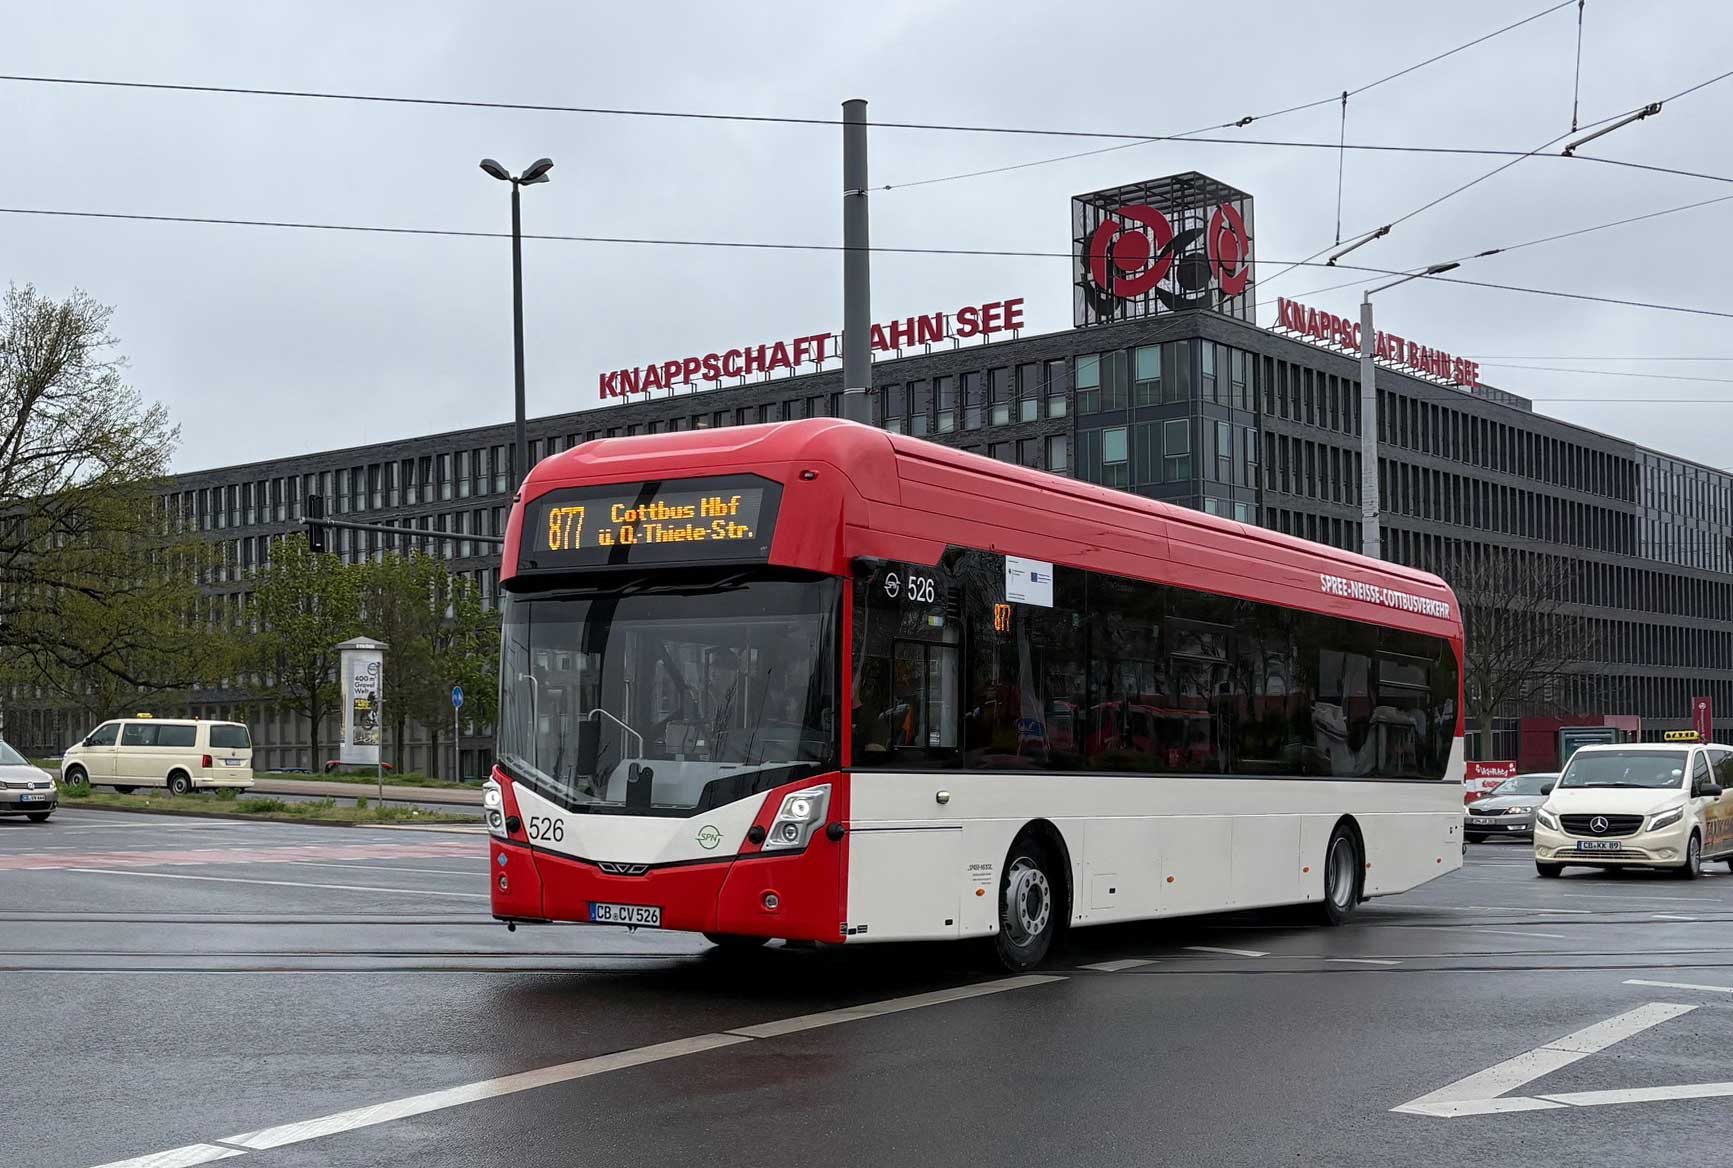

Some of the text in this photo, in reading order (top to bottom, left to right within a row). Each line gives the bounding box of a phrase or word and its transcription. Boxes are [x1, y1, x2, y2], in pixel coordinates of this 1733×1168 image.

[599, 297, 1024, 399] KNAPPSCHAFT AHN SEE
[1278, 296, 1480, 388] KNAPPSCAFT BAHN SEE
[611, 495, 741, 523] Cottbus Hbf
[549, 506, 585, 551] 877
[907, 575, 935, 603] 526
[1320, 573, 1450, 619] SPREE-NEISSE-COTTBUSVERKEHR
[529, 816, 565, 842] 526
[700, 831, 719, 842] SPN
[596, 905, 658, 923] CB CV 526
